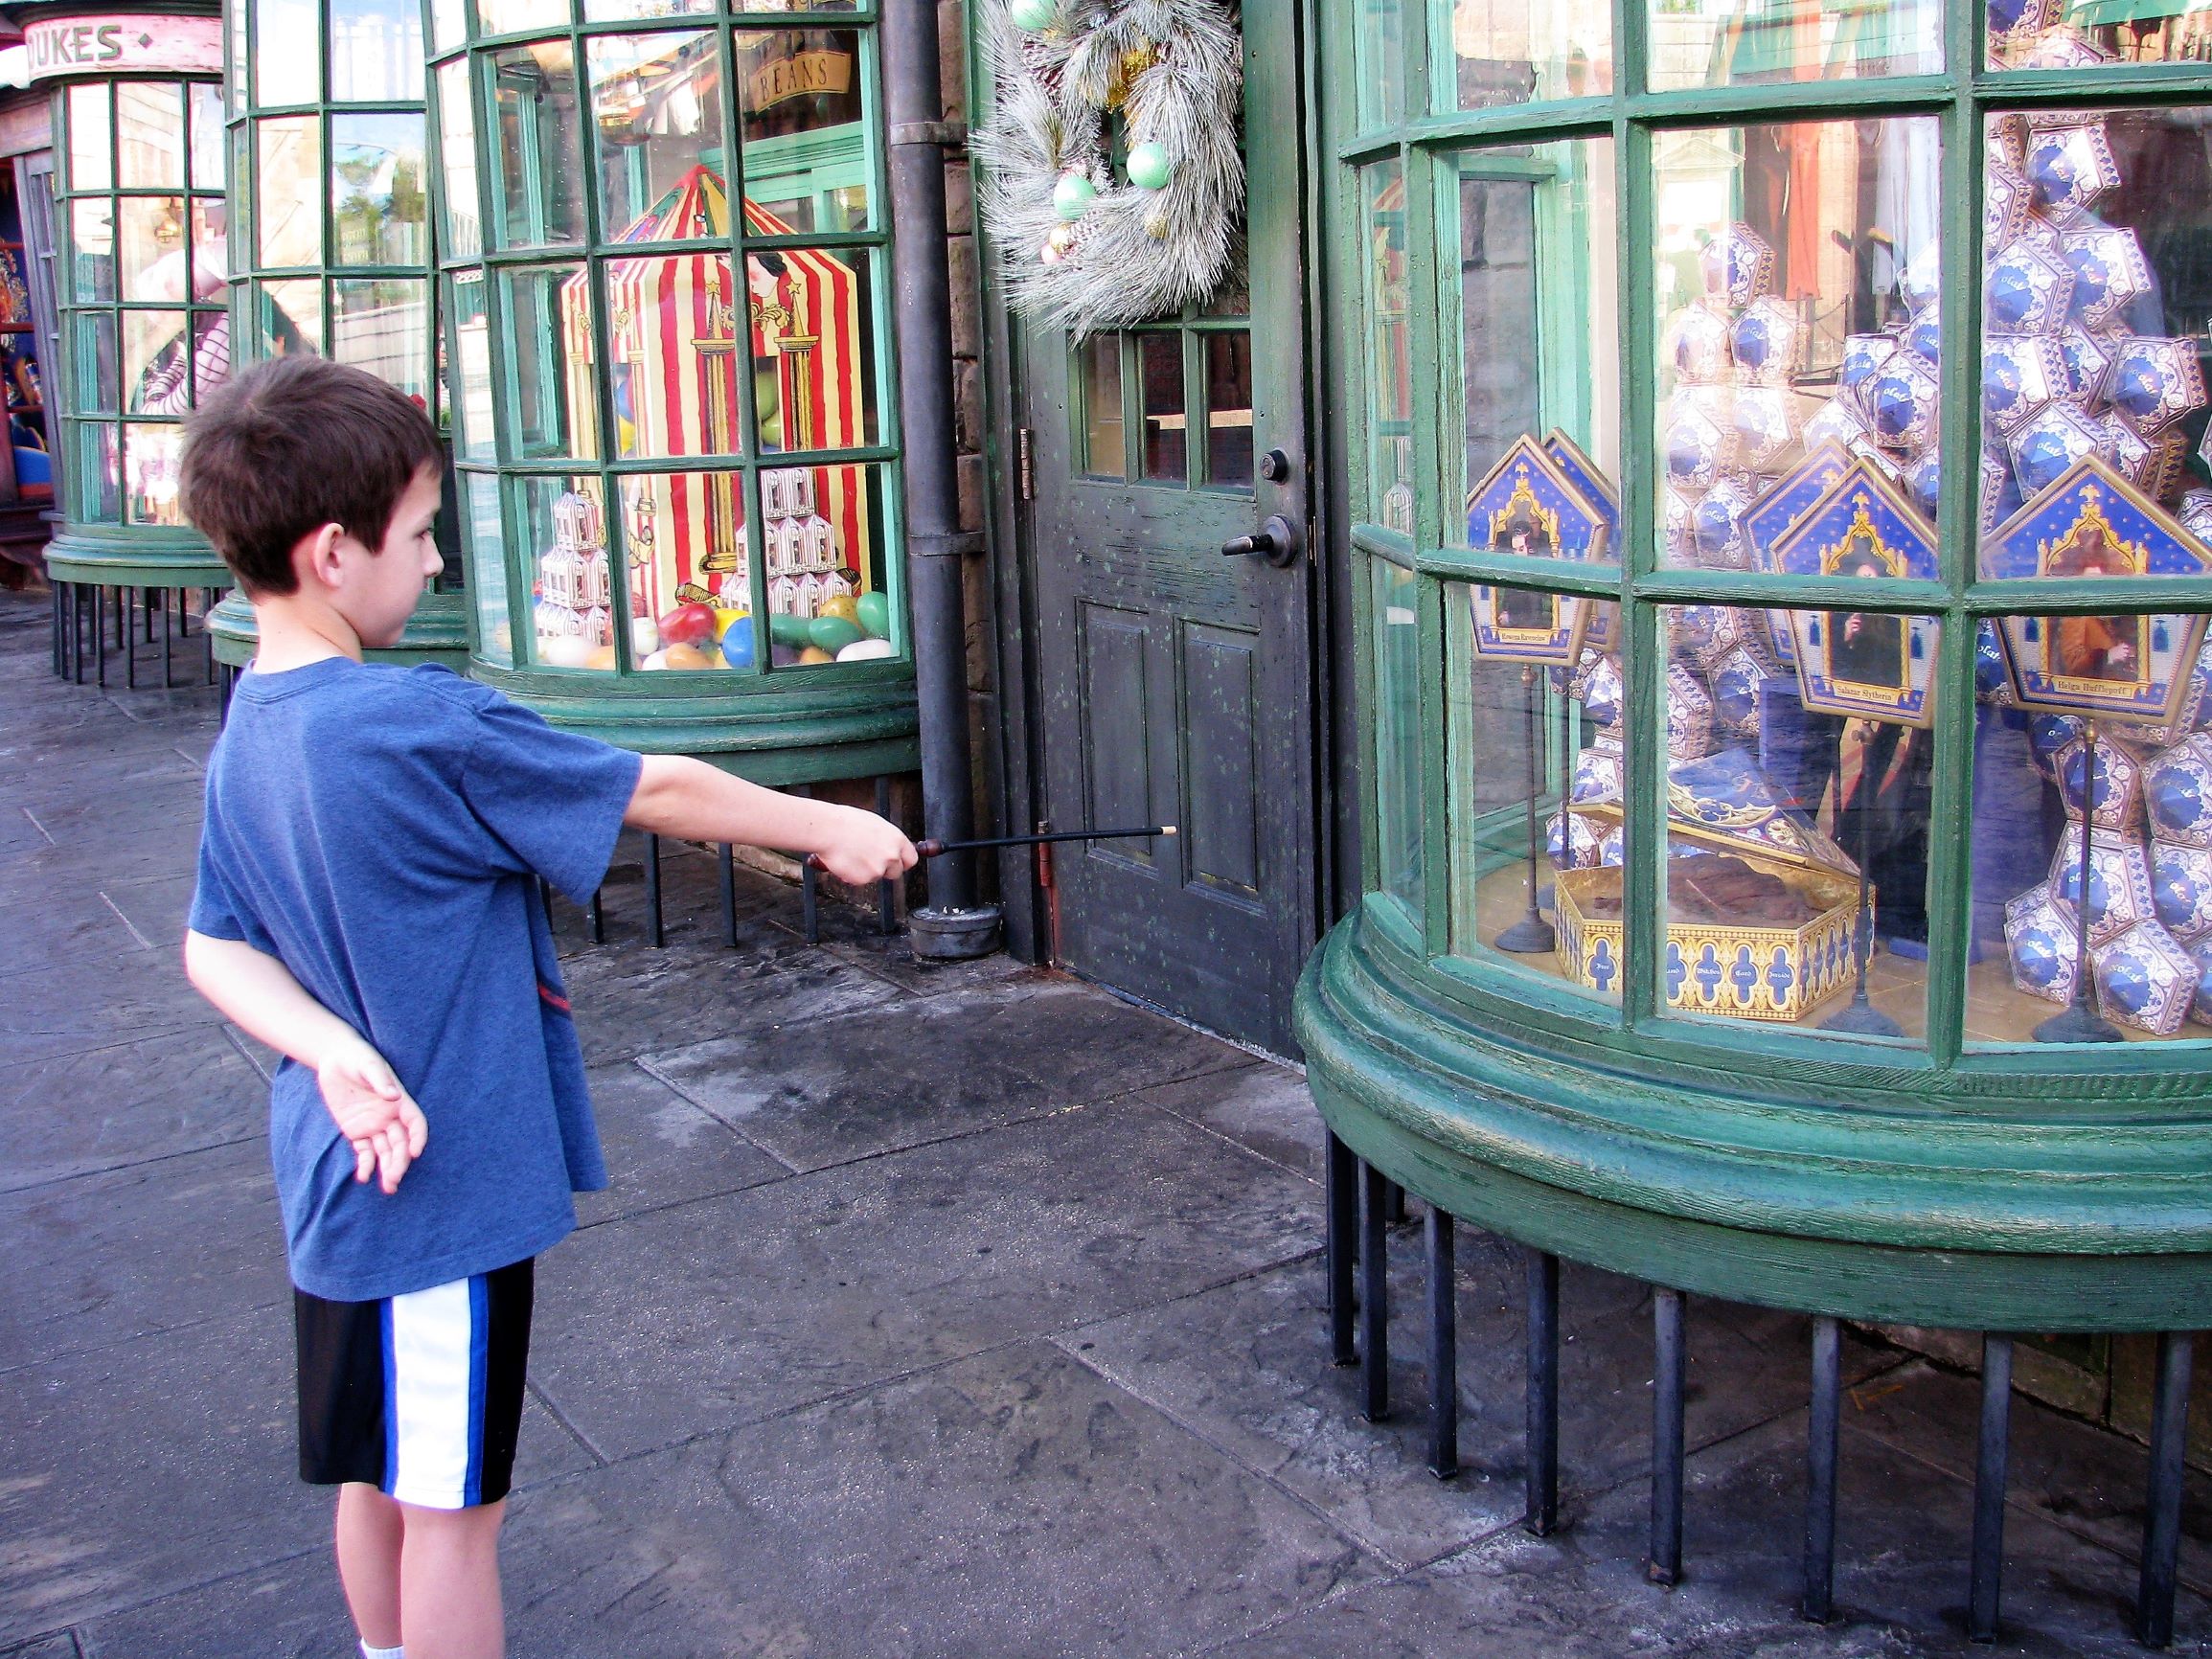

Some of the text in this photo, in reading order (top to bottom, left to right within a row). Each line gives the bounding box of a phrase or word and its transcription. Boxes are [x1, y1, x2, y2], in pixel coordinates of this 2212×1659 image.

[760, 58, 828, 102] BEANS
[1836, 685, 1892, 701] Salazar Slytherin
[2058, 680, 2081, 692] Helga
